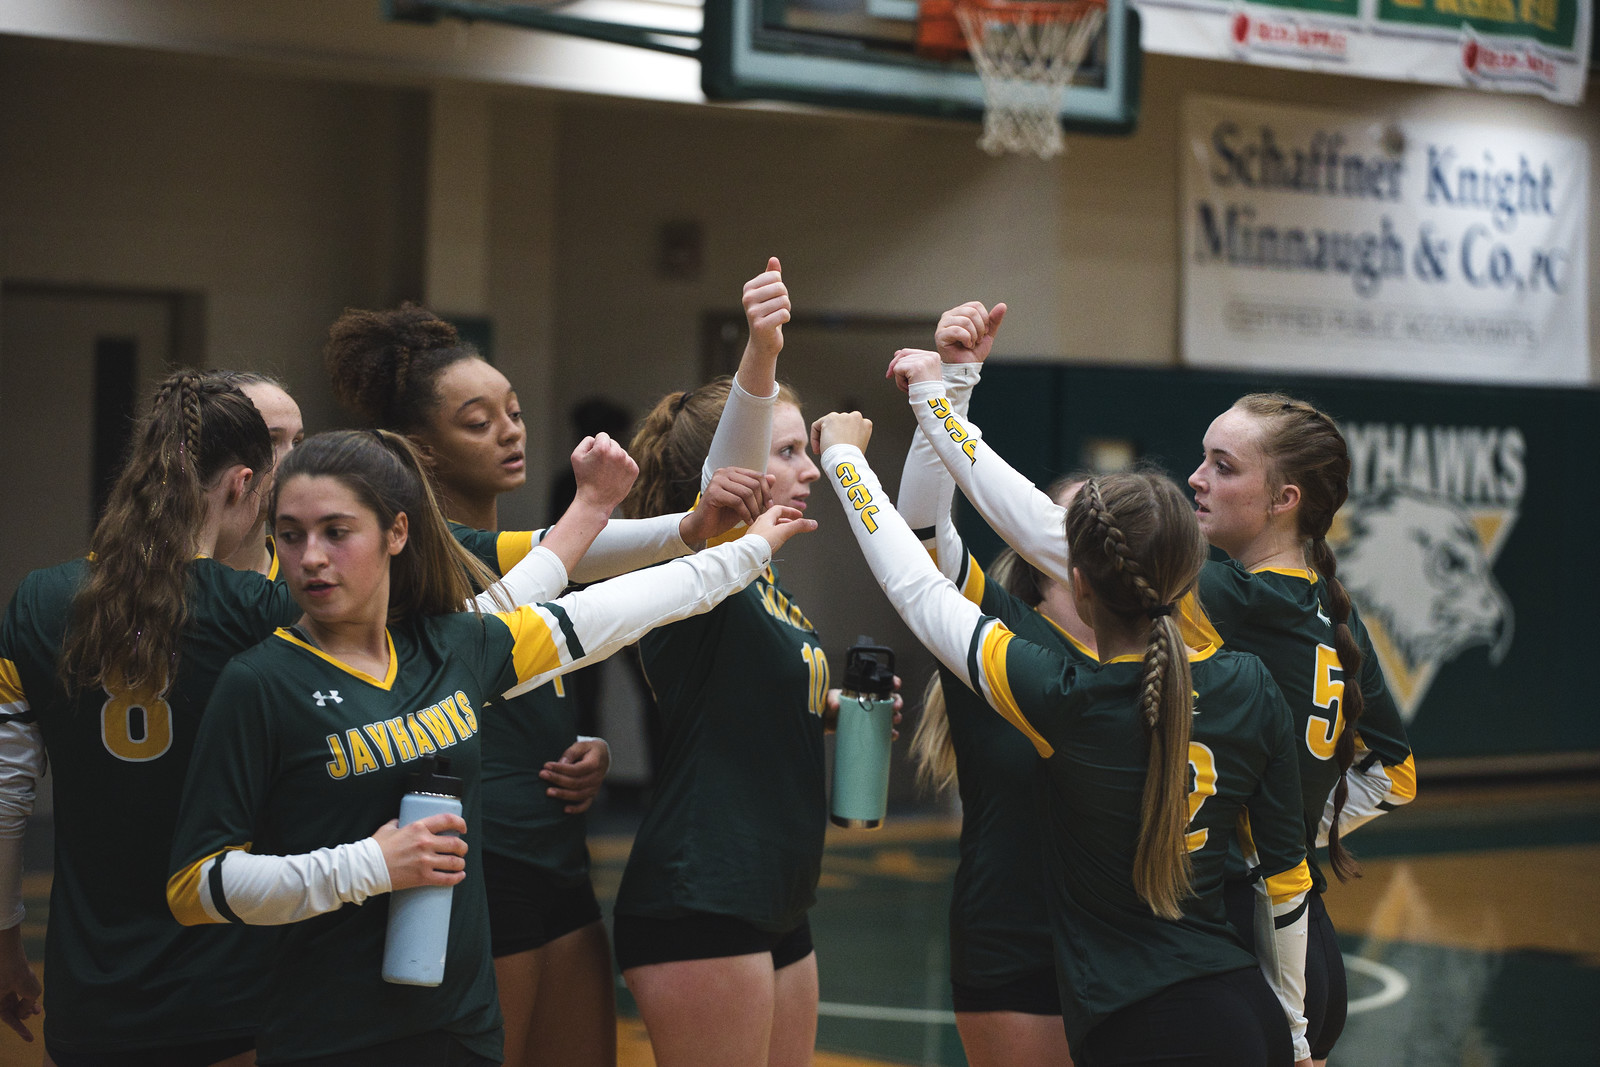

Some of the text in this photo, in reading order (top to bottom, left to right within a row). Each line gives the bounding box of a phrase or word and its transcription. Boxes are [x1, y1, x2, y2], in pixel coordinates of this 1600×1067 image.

[1211, 120, 1556, 233] Schaffner Knight
[1195, 202, 1404, 297] Minnaugh
[1413, 219, 1450, 284] &
[1344, 423, 1527, 498] YHAWKS
[101, 652, 173, 762] 8
[801, 641, 830, 718] 10
[1305, 643, 1346, 760] 5
[325, 690, 479, 780] JAYHAWKS
